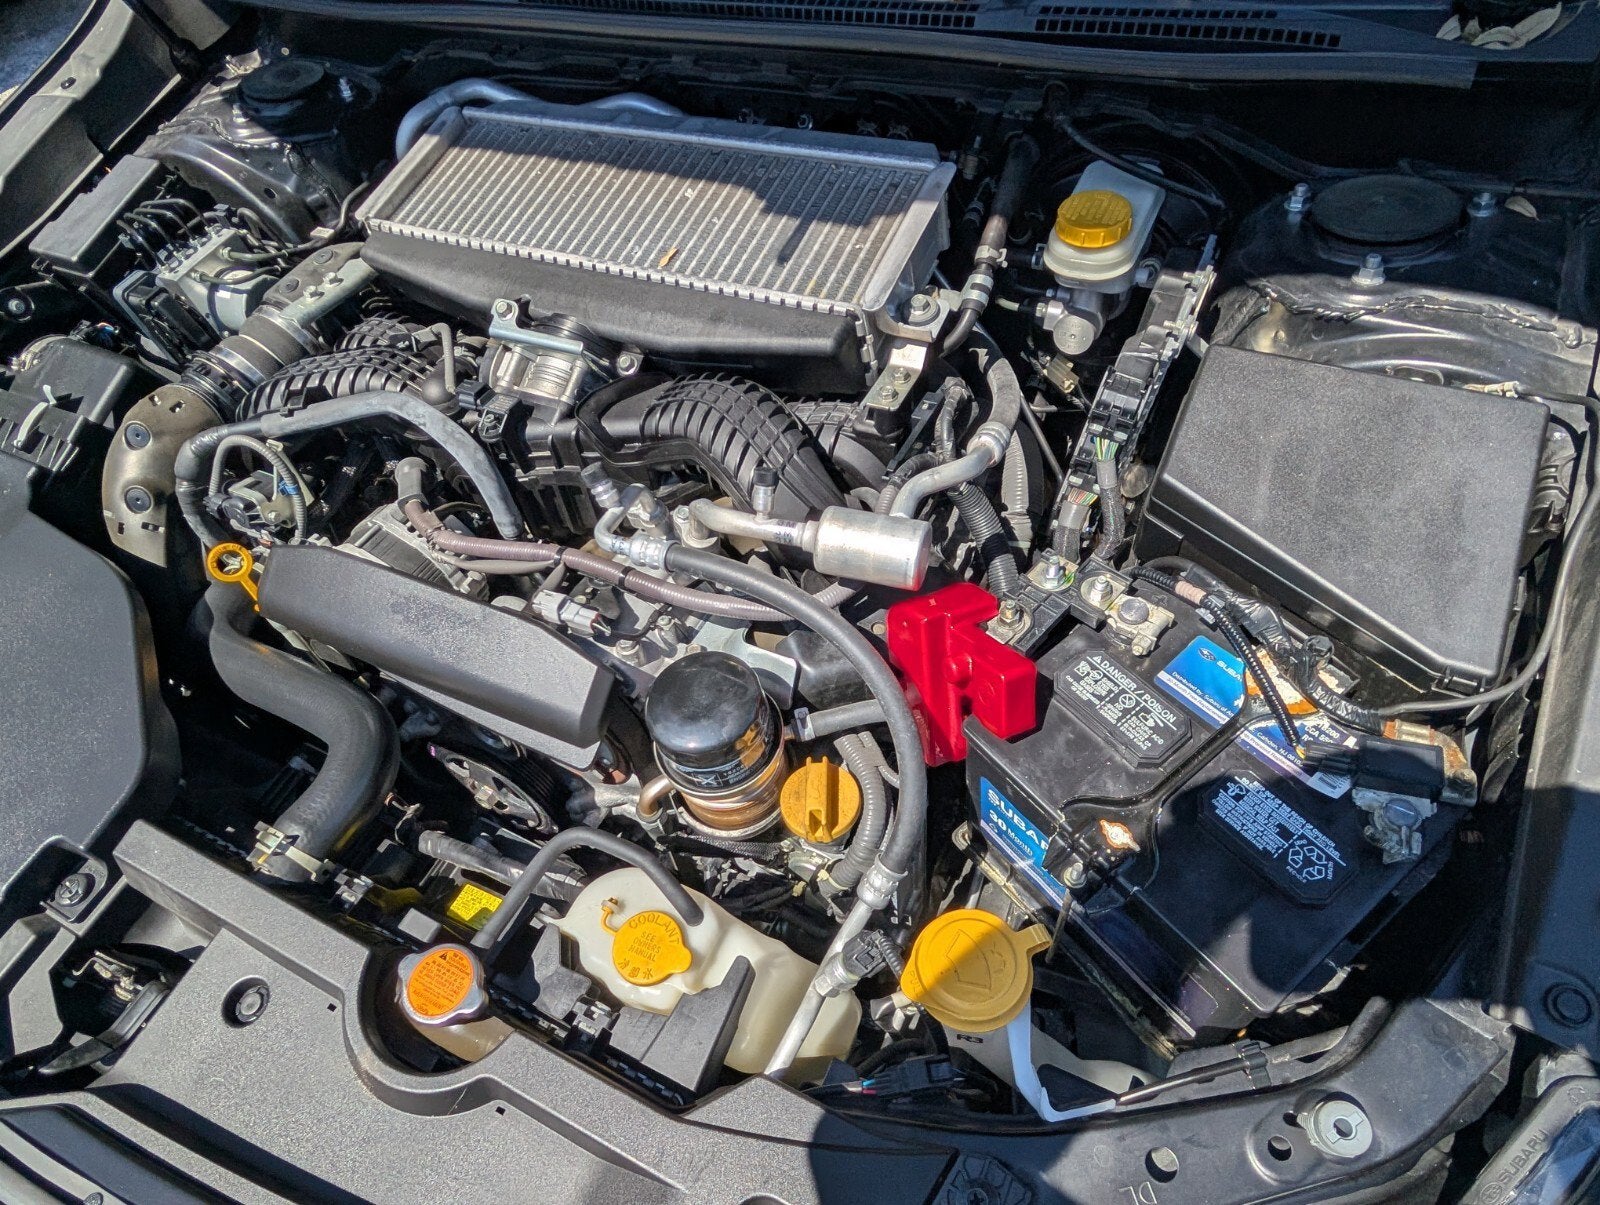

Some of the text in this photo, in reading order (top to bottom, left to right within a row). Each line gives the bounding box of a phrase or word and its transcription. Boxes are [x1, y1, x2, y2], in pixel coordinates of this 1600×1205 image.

[1217, 660, 1243, 682] SUBA
[1100, 659, 1176, 723] DANGER / POISON
[1171, 671, 1197, 690] Distributed
[1203, 694, 1221, 708] Subaru
[1113, 702, 1123, 711] NO
[1150, 732, 1164, 745] ACID
[1304, 724, 1319, 737] CCA
[1256, 731, 1280, 750] Camden,
[1278, 747, 1288, 755] NJ
[1241, 777, 1249, 785] DO
[1315, 837, 1326, 847] AND
[1325, 845, 1340, 858] LEVEL
[1255, 813, 1268, 824] HELP
[1266, 822, 1279, 833] FAST
[1264, 790, 1274, 799] OUT
[1273, 797, 1282, 805] OF
[1280, 803, 1291, 813] THE
[1289, 810, 1306, 825] REACH
[1304, 822, 1312, 830] OF
[1311, 827, 1335, 847] CHILDREN
[989, 809, 1033, 856] 30 Month
[629, 913, 680, 945] COOLANT
[641, 931, 656, 942] SEE
[628, 944, 656, 962] MANUAL
[633, 936, 661, 954] OWNERS
[1499, 1129, 1549, 1182] SUBARU
